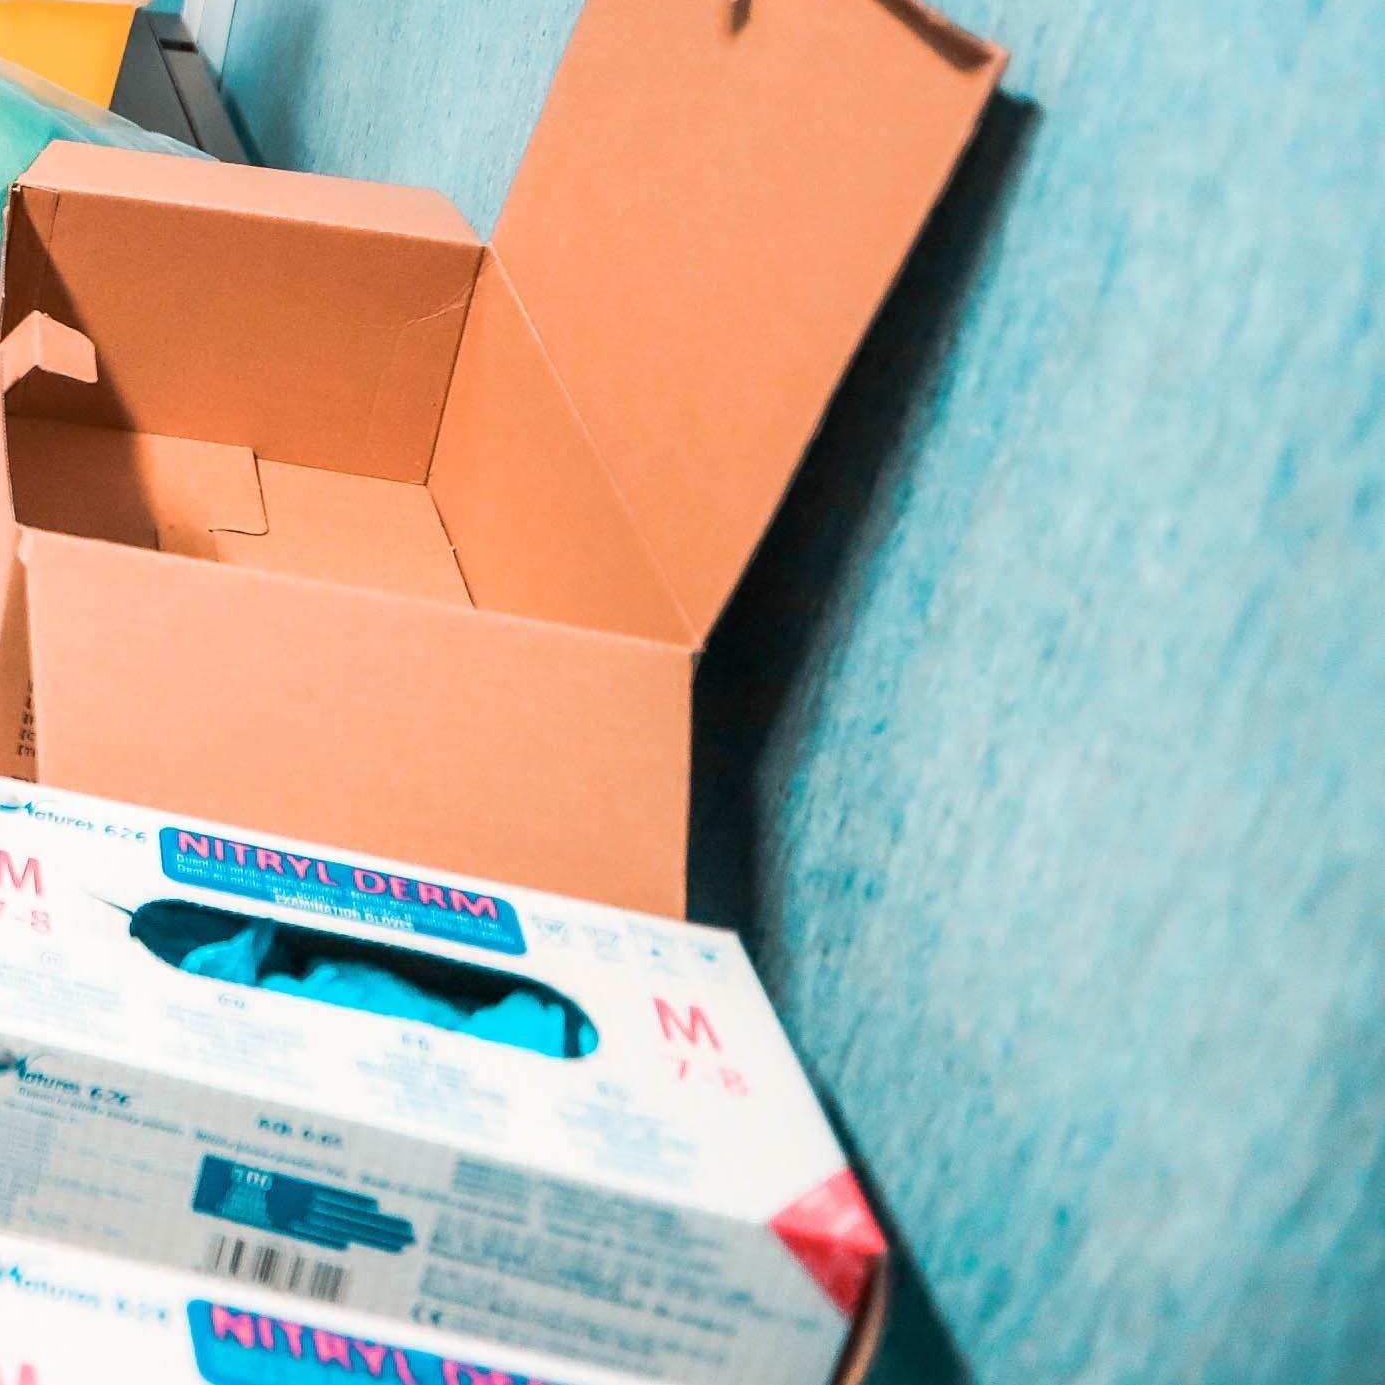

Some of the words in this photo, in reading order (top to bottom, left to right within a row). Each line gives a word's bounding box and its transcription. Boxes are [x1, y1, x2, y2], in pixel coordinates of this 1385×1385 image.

[177, 830, 339, 888] NITRYL
[352, 867, 499, 921] DERM
[653, 998, 723, 1052] M
